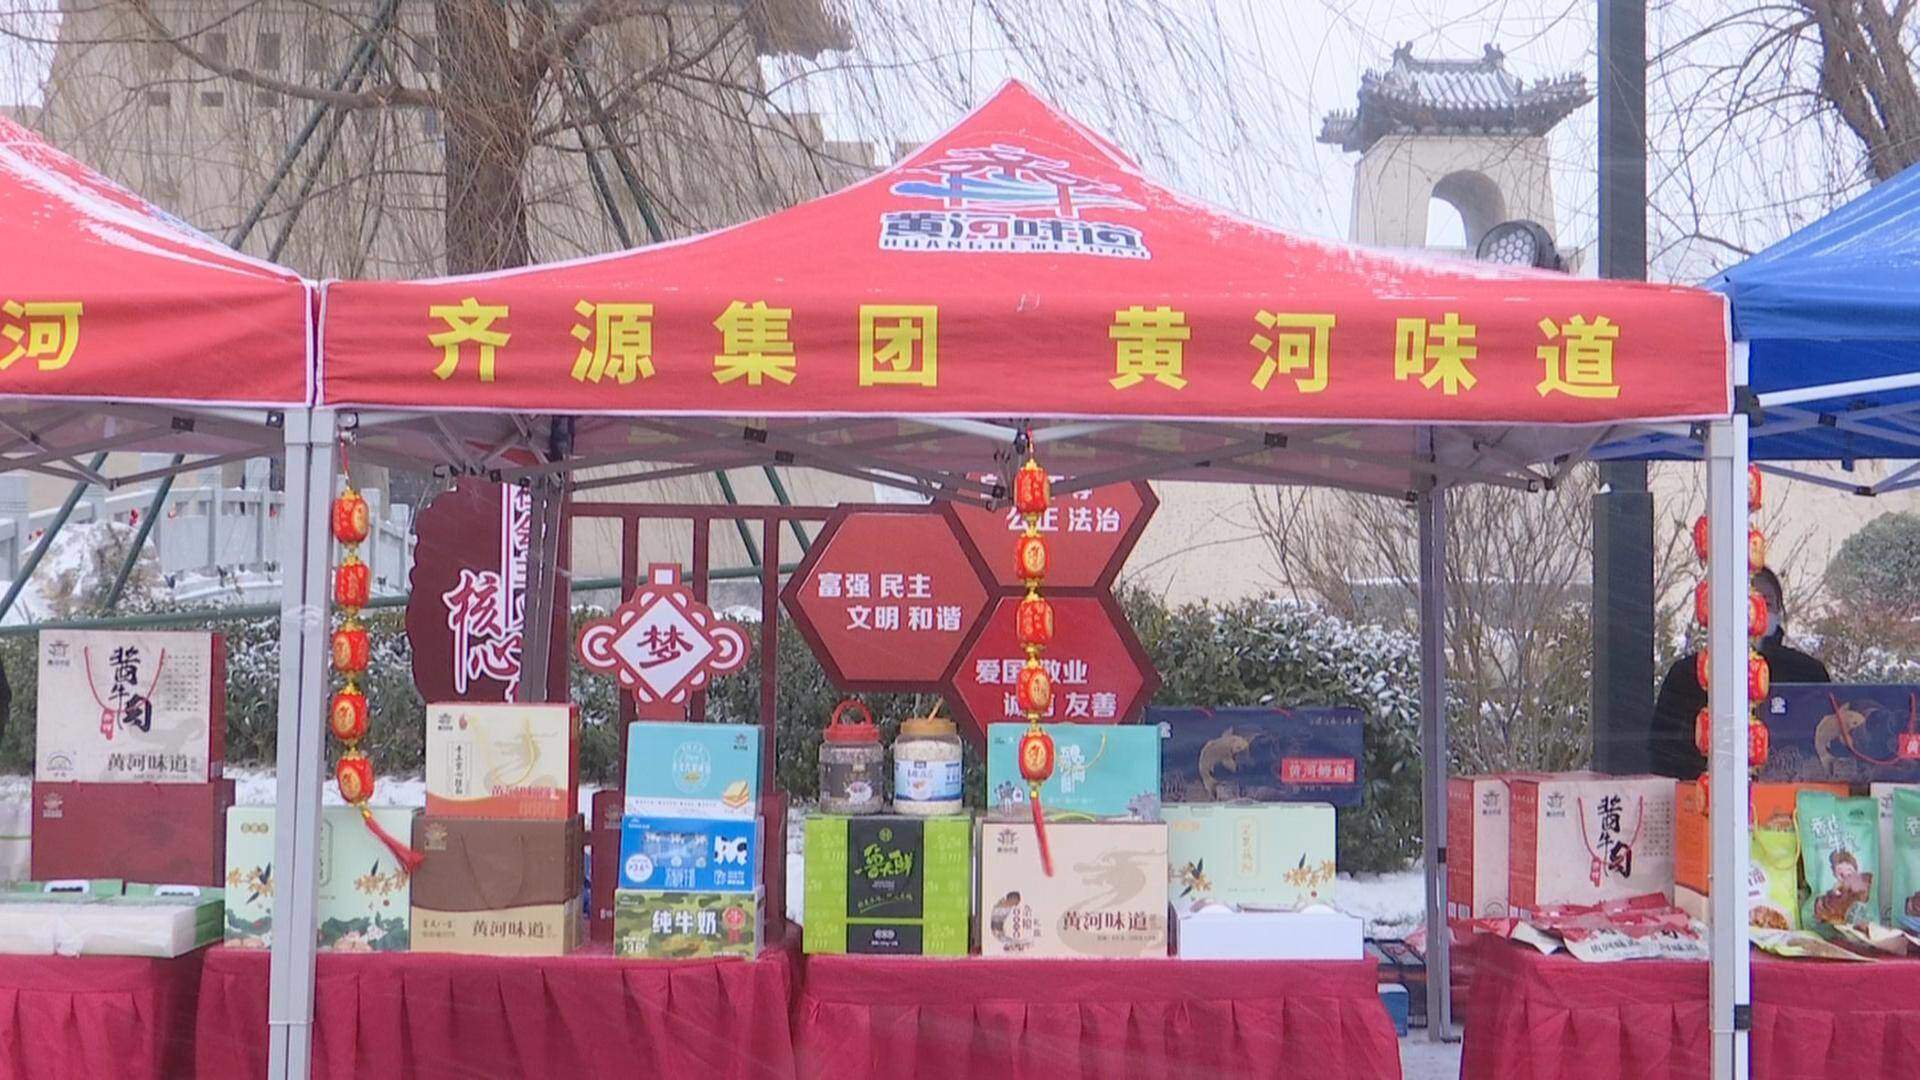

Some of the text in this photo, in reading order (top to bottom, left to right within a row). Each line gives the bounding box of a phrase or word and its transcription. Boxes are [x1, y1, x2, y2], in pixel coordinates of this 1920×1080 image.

[0, 300, 83, 371] 河
[428, 297, 1621, 399] 齐源集团 黄河味道
[1067, 506, 1121, 532] 法治
[817, 573, 932, 599] 富强 民主
[846, 605, 962, 631] 文明 和谐
[635, 624, 694, 669] 梦
[1003, 691, 1117, 718] 诚 友善
[107, 752, 188, 774] 黄河味道
[472, 919, 545, 938] 黄河味道
[652, 909, 717, 935] 纯牛奶
[1063, 911, 1147, 931] 黄河味道
